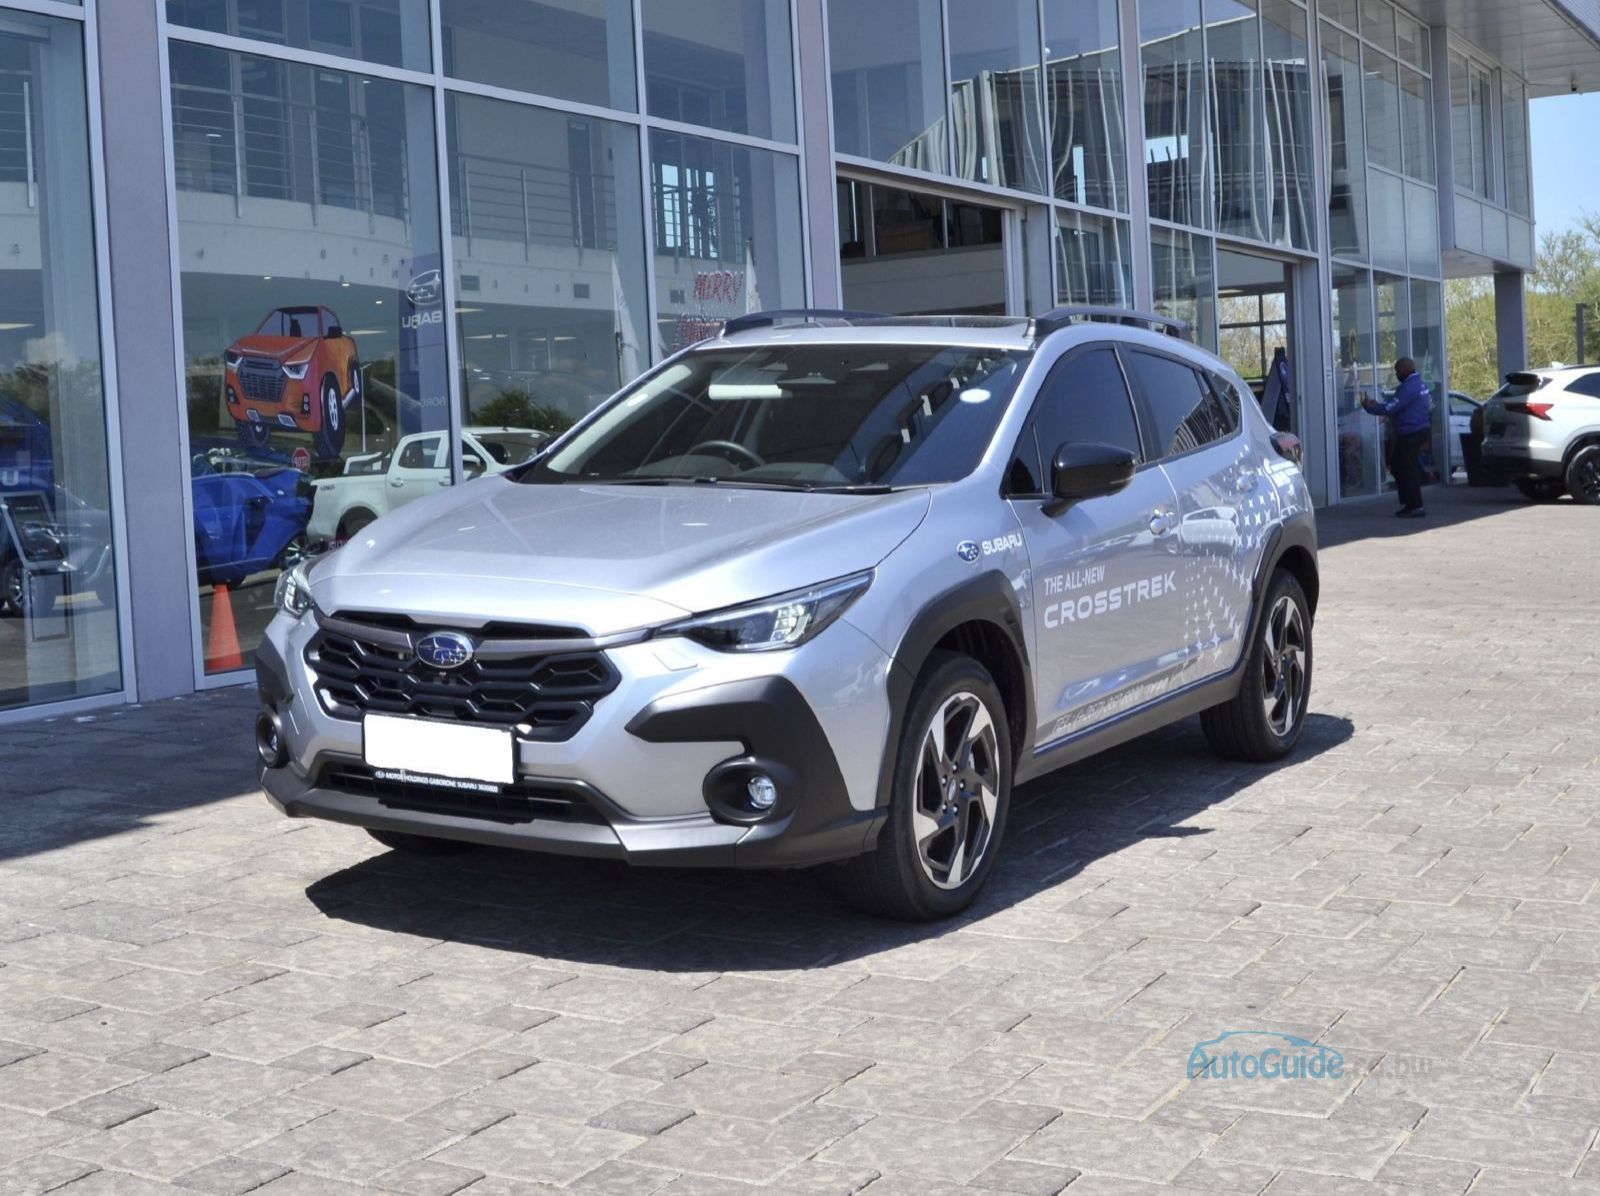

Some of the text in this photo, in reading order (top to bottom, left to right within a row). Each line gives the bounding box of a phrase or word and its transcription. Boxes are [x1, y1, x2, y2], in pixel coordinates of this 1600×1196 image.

[981, 532, 1023, 556] SUBARU
[1044, 565, 1106, 597] THE ALL-NEW
[1043, 570, 1177, 630] CROSSTREK
